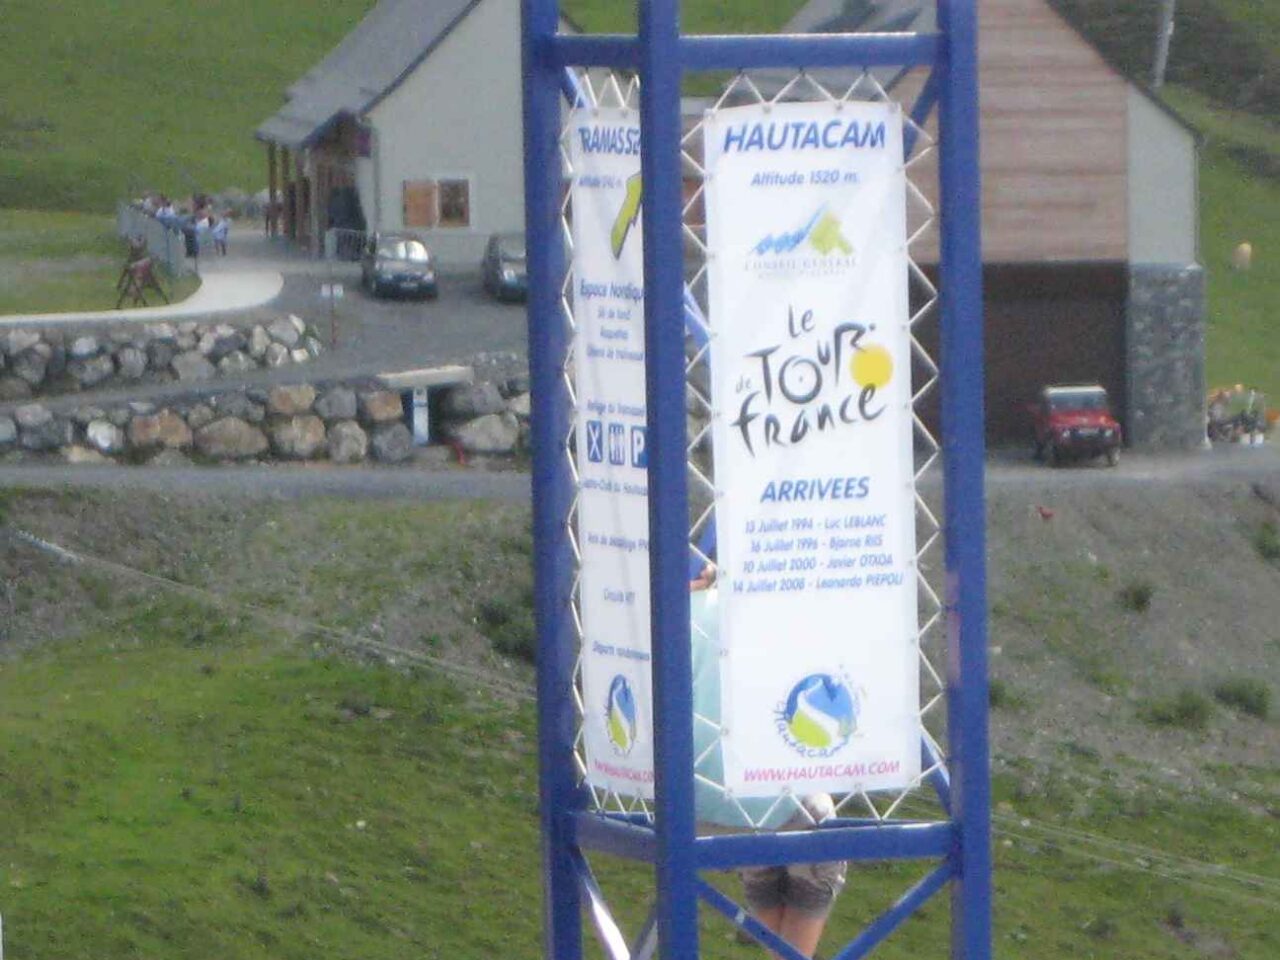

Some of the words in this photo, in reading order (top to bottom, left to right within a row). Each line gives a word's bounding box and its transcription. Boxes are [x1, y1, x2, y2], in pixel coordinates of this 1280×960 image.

[723, 119, 886, 153] HAUTACAM
[751, 171, 805, 186] Altitude
[810, 169, 840, 184] 1520
[760, 476, 870, 503] ARRIVEES
[758, 519, 789, 533] Juillet
[824, 517, 841, 529] Luc
[844, 513, 887, 528] LEBLANC
[764, 539, 794, 552] Juillet
[757, 559, 787, 573] Juillet
[789, 556, 816, 571] 2000
[746, 579, 777, 593] Juillet
[743, 760, 900, 782] WWW.HAUTACAM.COM
